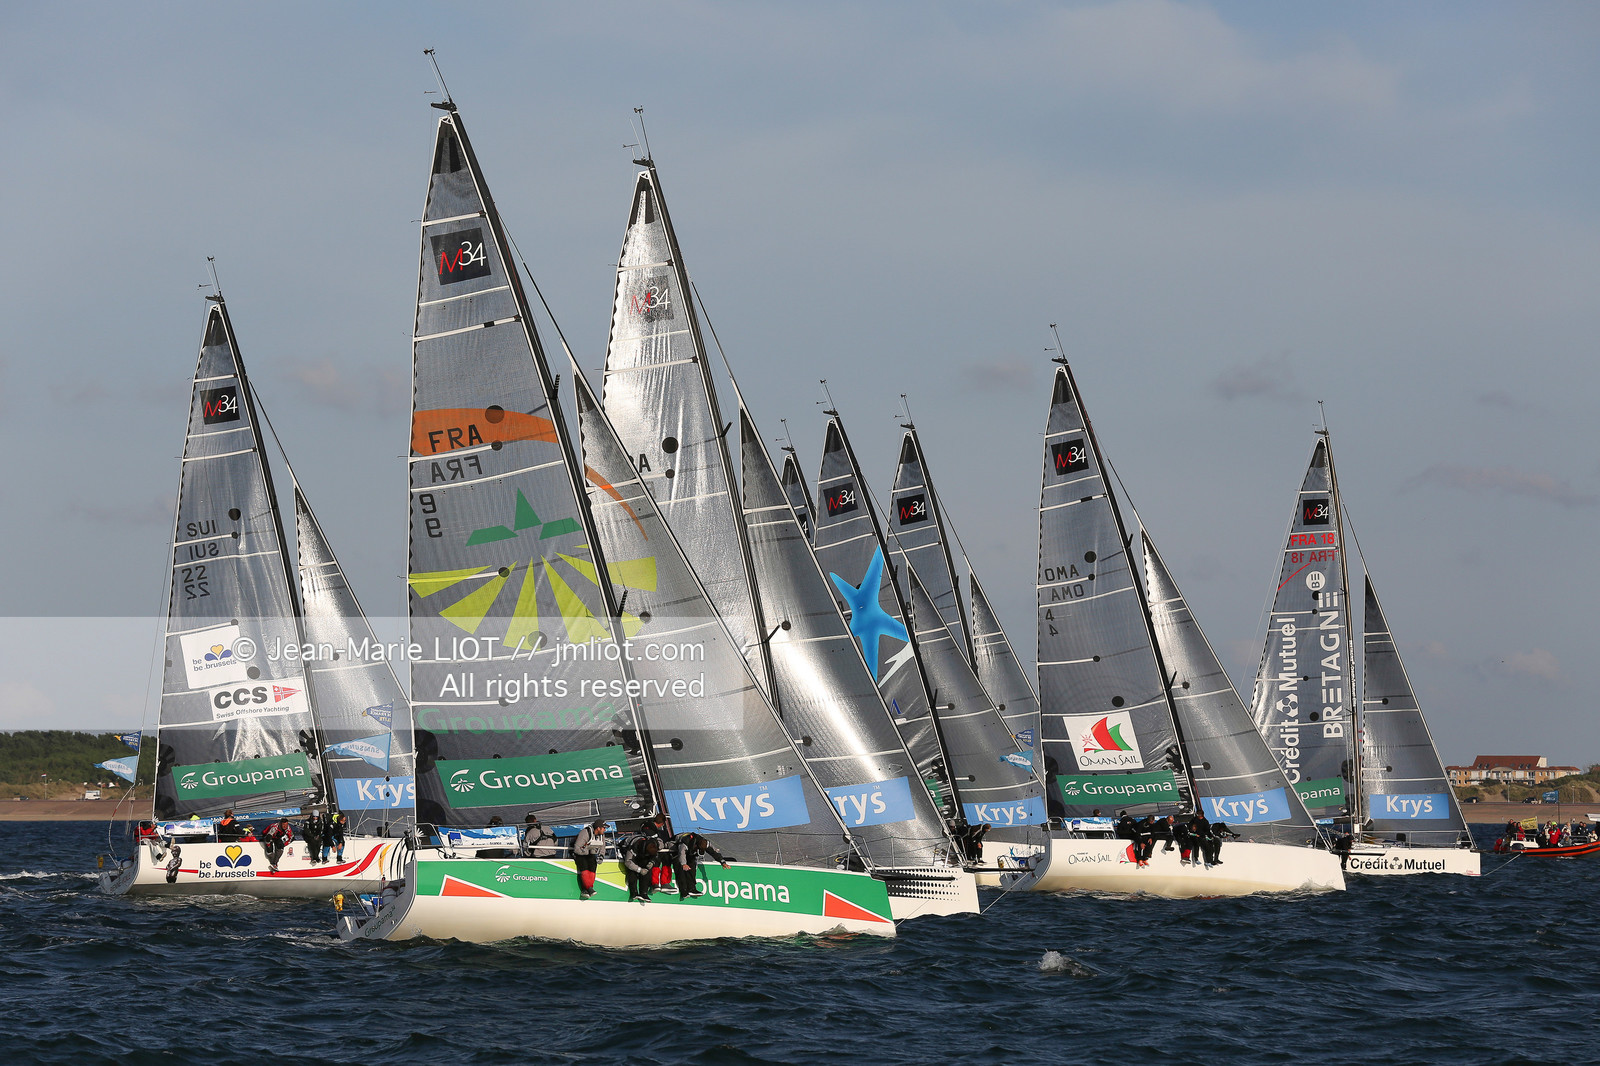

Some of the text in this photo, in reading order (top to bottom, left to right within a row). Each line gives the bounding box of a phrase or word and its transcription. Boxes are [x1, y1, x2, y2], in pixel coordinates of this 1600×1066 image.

[439, 241, 486, 275] M34
[629, 286, 670, 316] M34
[204, 395, 238, 418] M34
[428, 424, 484, 453] FRA
[1056, 447, 1087, 469] M34
[419, 493, 437, 514] 9
[828, 489, 856, 512] M34
[900, 500, 926, 521] M34
[1303, 503, 1329, 520] M34
[187, 519, 217, 538] SUI
[1290, 532, 1335, 547] FRA 18
[181, 565, 208, 584] 22
[1044, 564, 1080, 582] OMA
[1045, 608, 1055, 622] 4
[1276, 617, 1299, 692] Mutuel
[1315, 590, 1345, 739] BRETAGNE
[213, 686, 268, 709] CCS
[216, 705, 290, 719] Swiss Offshore Yachting
[416, 702, 617, 739] Groupama
[202, 765, 305, 786] Groupama
[479, 765, 624, 790] Groupama
[356, 779, 416, 807] Krys
[1082, 781, 1173, 797] Groupama
[1297, 785, 1341, 802] pama
[683, 790, 775, 829] Krys
[827, 790, 886, 825] rys
[974, 804, 1028, 826] Krys
[1211, 797, 1269, 822] Krys
[1386, 795, 1433, 818] Krys
[200, 860, 212, 869] be
[1350, 858, 1446, 870] Crédit Mutuel
[512, 873, 548, 882] Groupama
[671, 866, 790, 905] oupama
